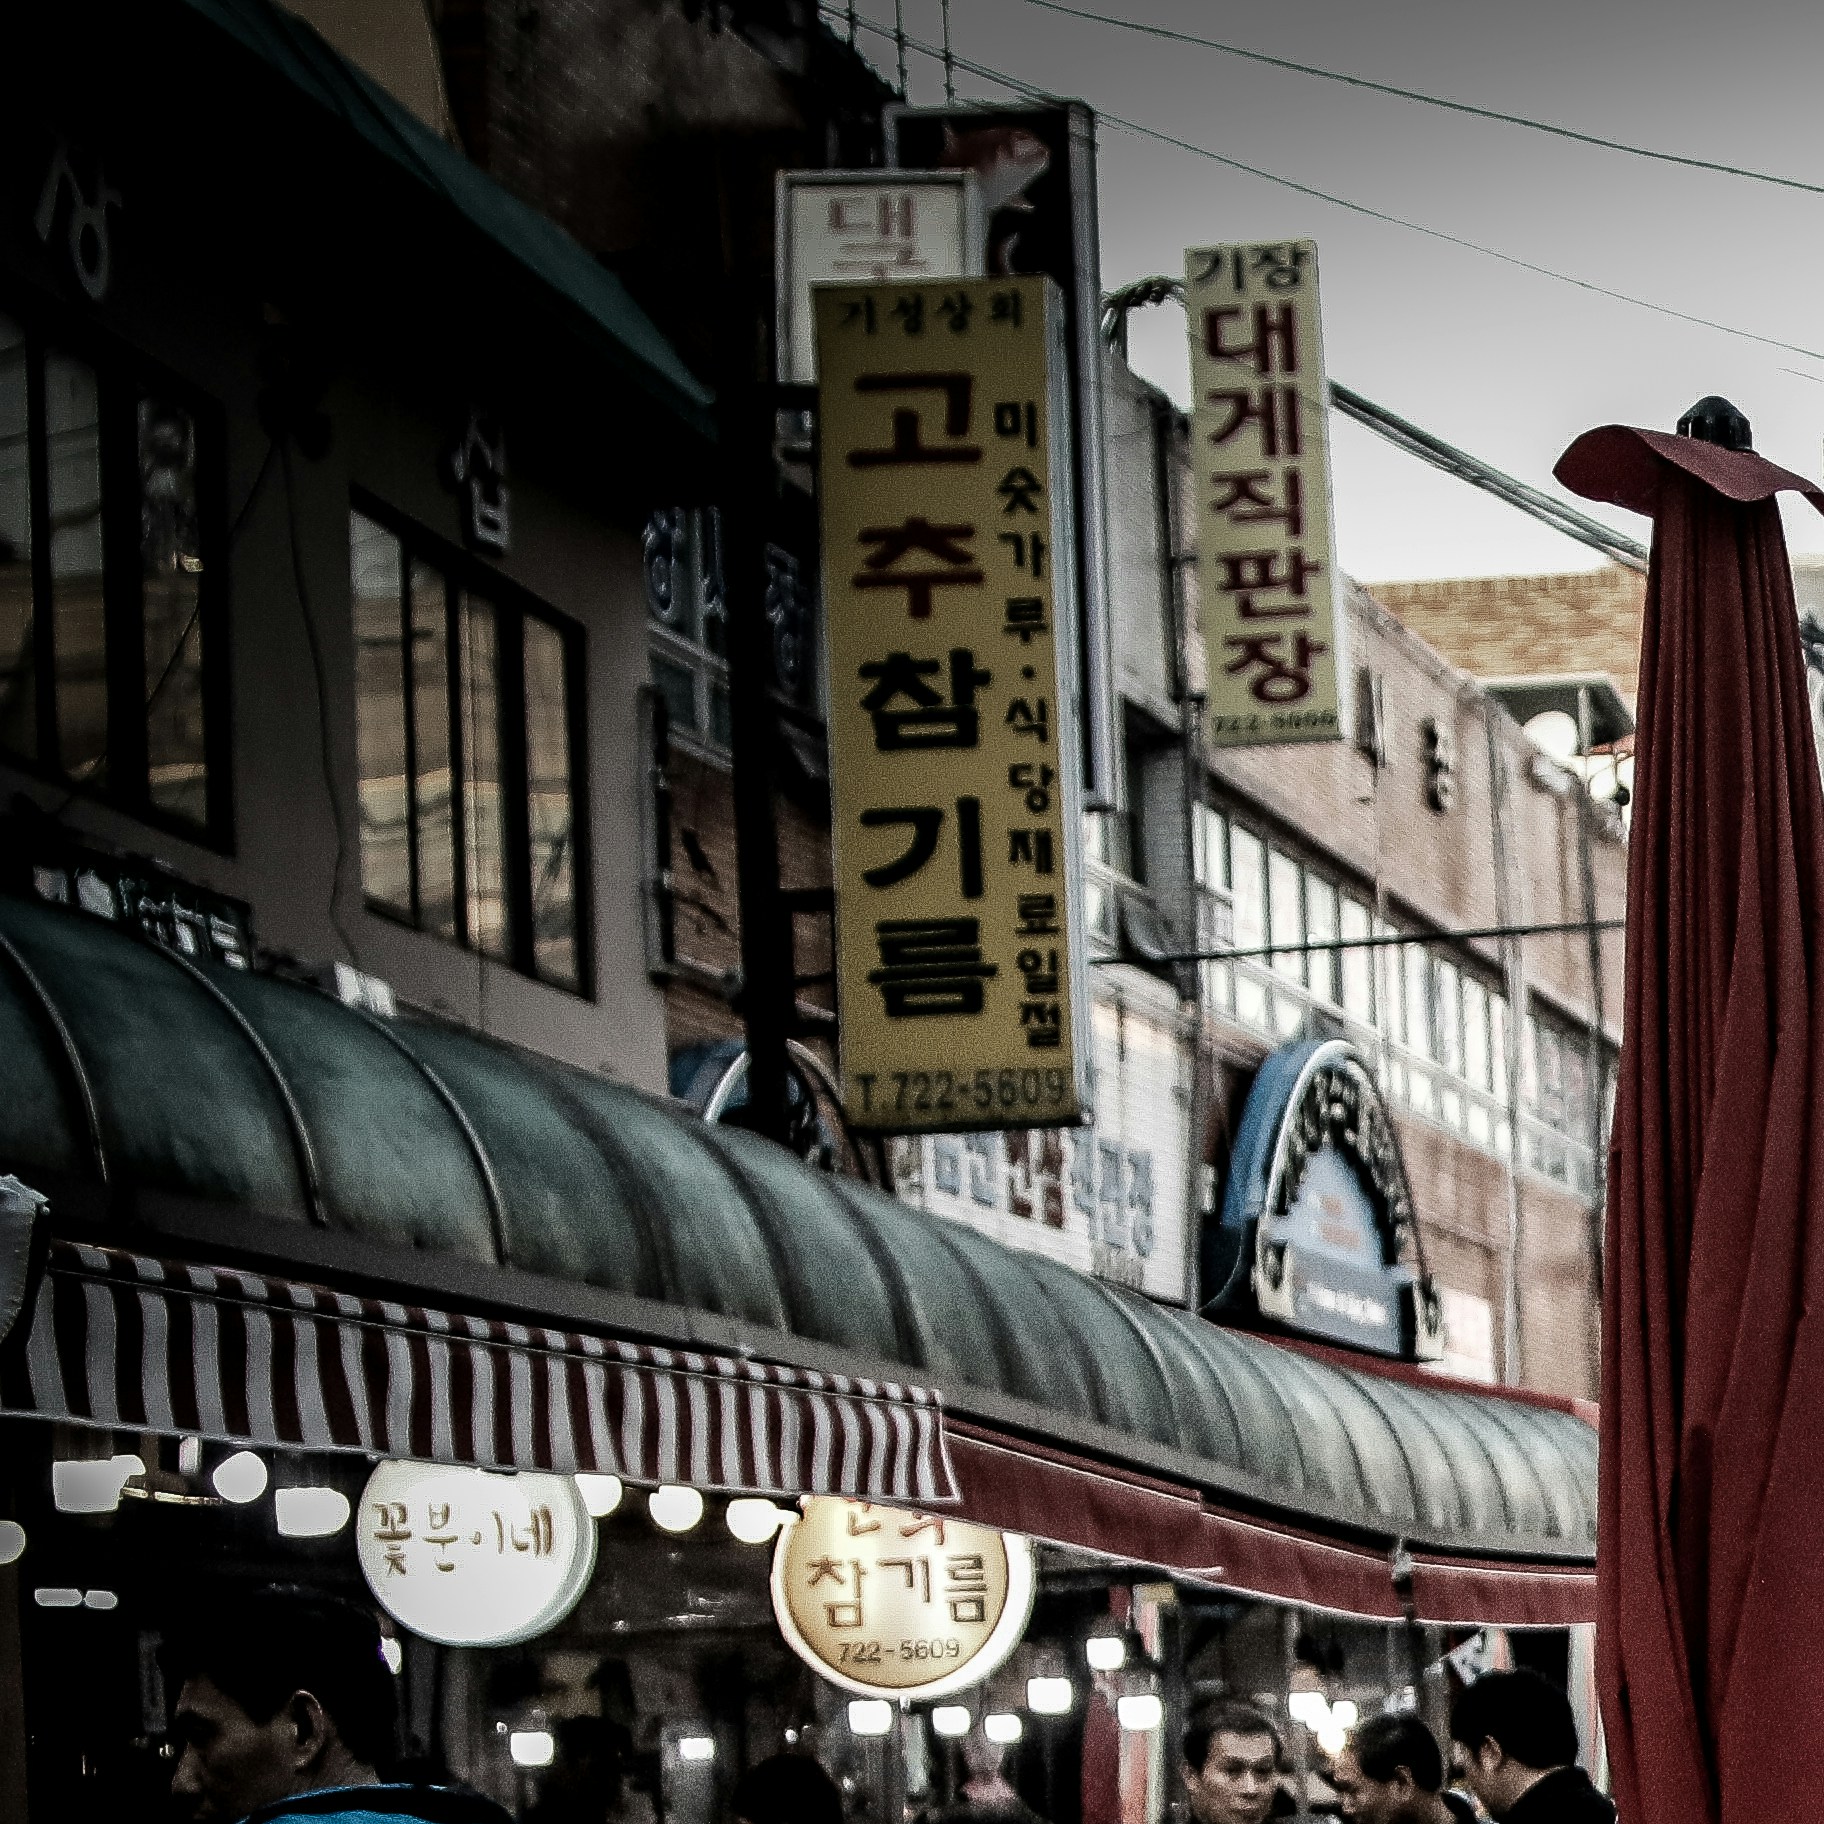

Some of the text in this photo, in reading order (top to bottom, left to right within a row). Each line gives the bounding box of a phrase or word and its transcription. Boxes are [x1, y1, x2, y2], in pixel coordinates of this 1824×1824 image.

[1190, 246, 1310, 292] 기장
[847, 372, 984, 619] 고추
[1202, 303, 1330, 706] 대게직판장
[859, 647, 999, 1018] 참기름
[372, 1502, 556, 1578] 꽃분이네
[805, 1554, 989, 1628] 참기름
[837, 1638, 961, 1664] 722-5609
